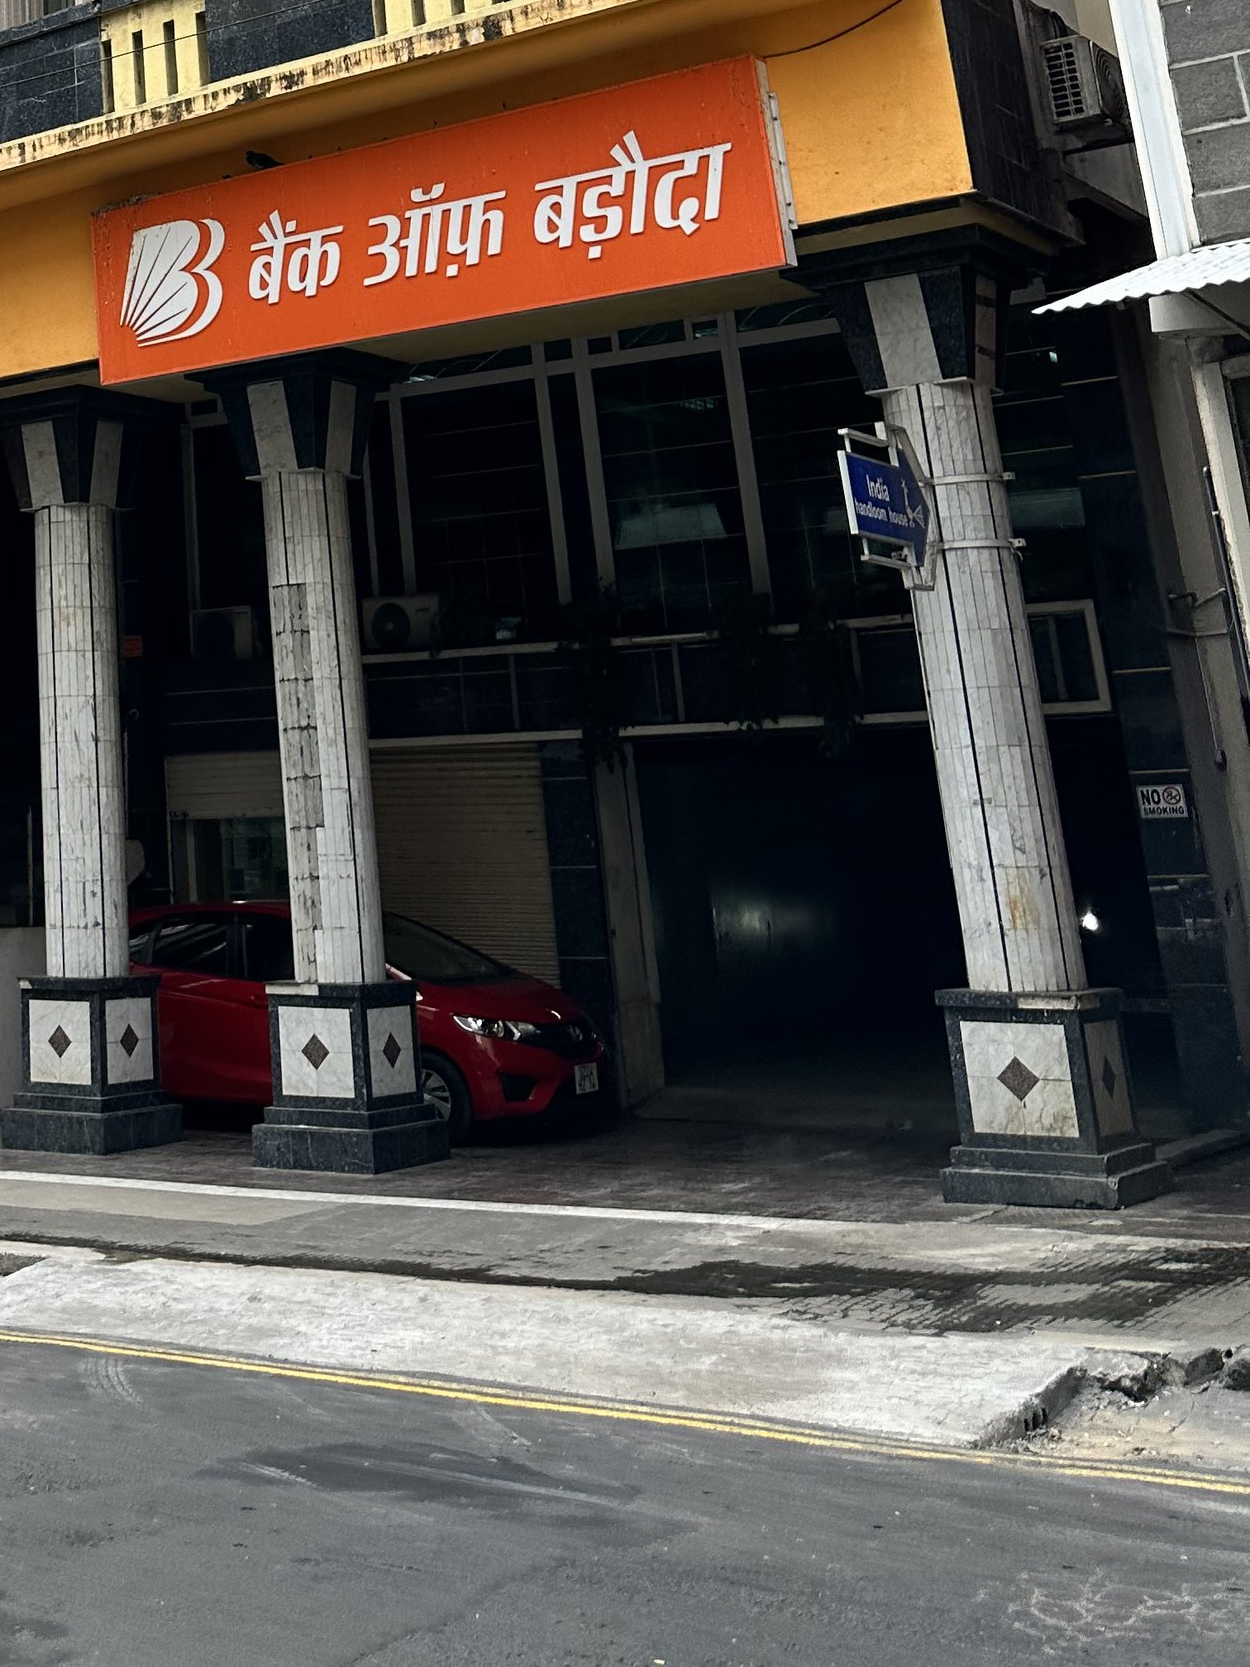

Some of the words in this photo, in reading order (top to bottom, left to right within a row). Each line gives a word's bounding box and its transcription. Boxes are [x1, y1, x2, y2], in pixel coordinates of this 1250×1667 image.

[248, 210, 344, 305] बैंक
[363, 182, 507, 287] ऑफ़
[534, 130, 732, 260] बड़ौदा
[866, 474, 890, 502] India
[854, 496, 889, 522] handloom
[888, 505, 909, 527] house
[1140, 789, 1161, 805] NO
[1144, 805, 1185, 815] SMOKING
